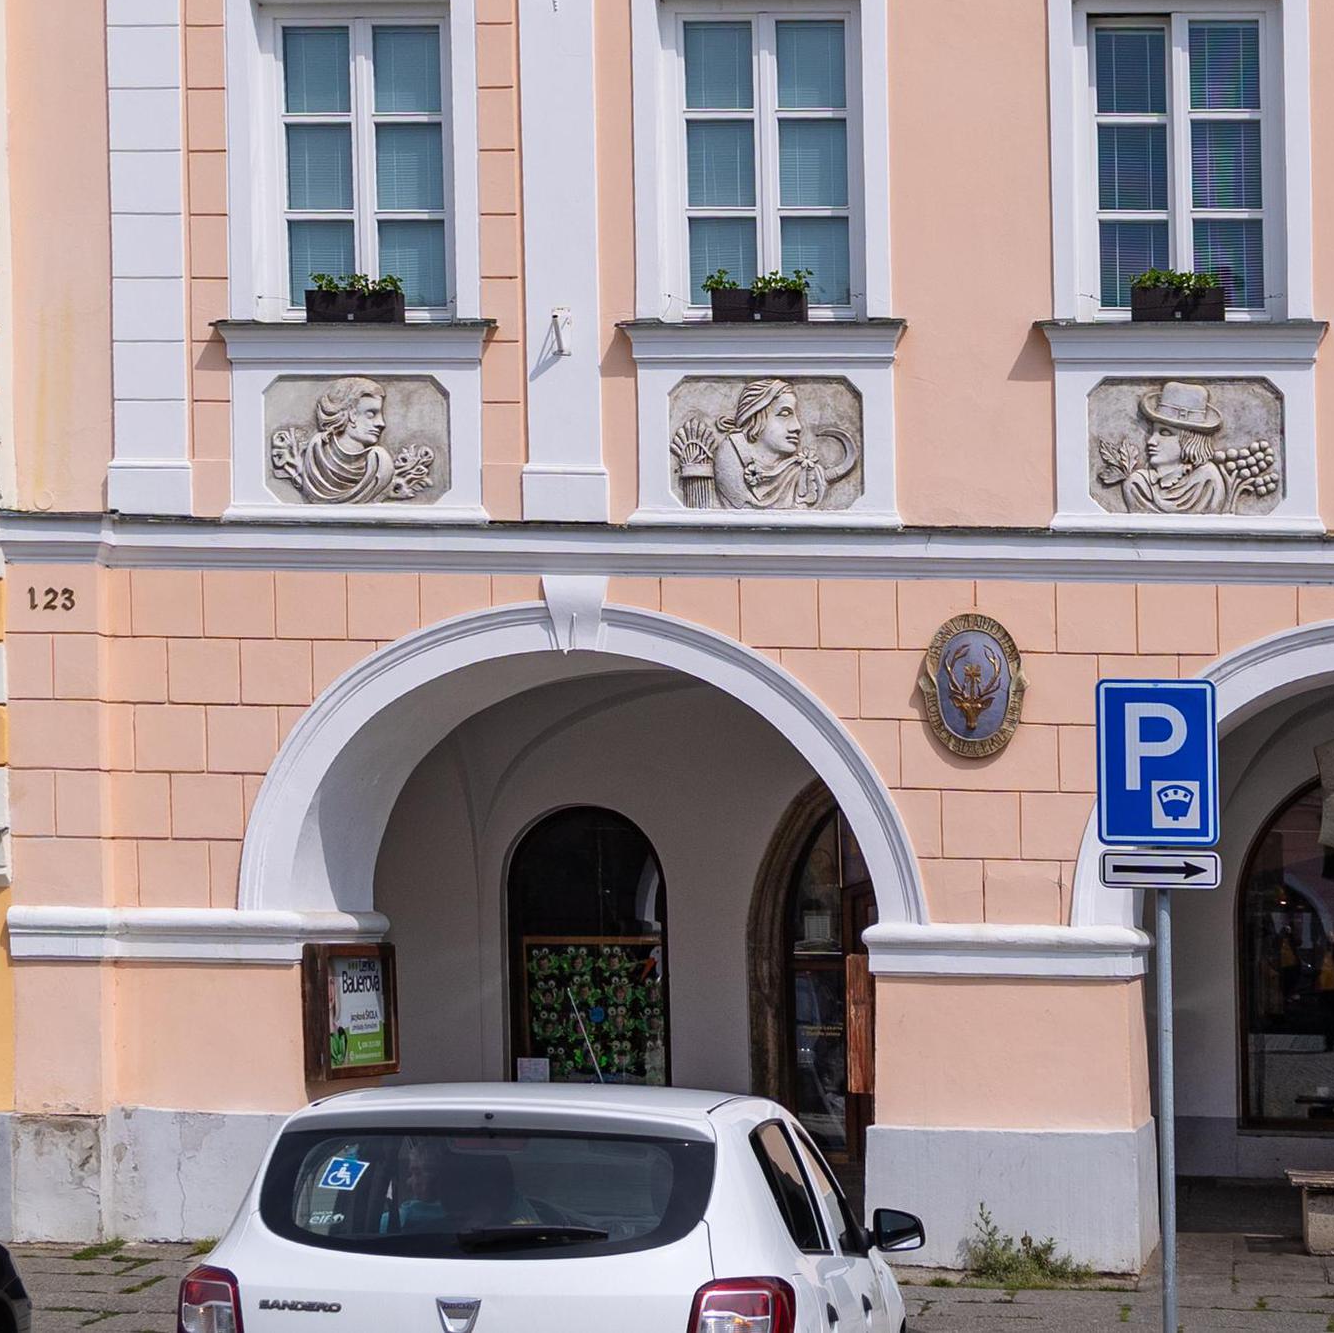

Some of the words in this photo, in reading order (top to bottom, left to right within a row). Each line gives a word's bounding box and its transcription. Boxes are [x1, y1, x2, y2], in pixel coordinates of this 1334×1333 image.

[27, 586, 75, 611] 123
[1124, 702, 1187, 790] P
[258, 1299, 342, 1313] SANDERO
